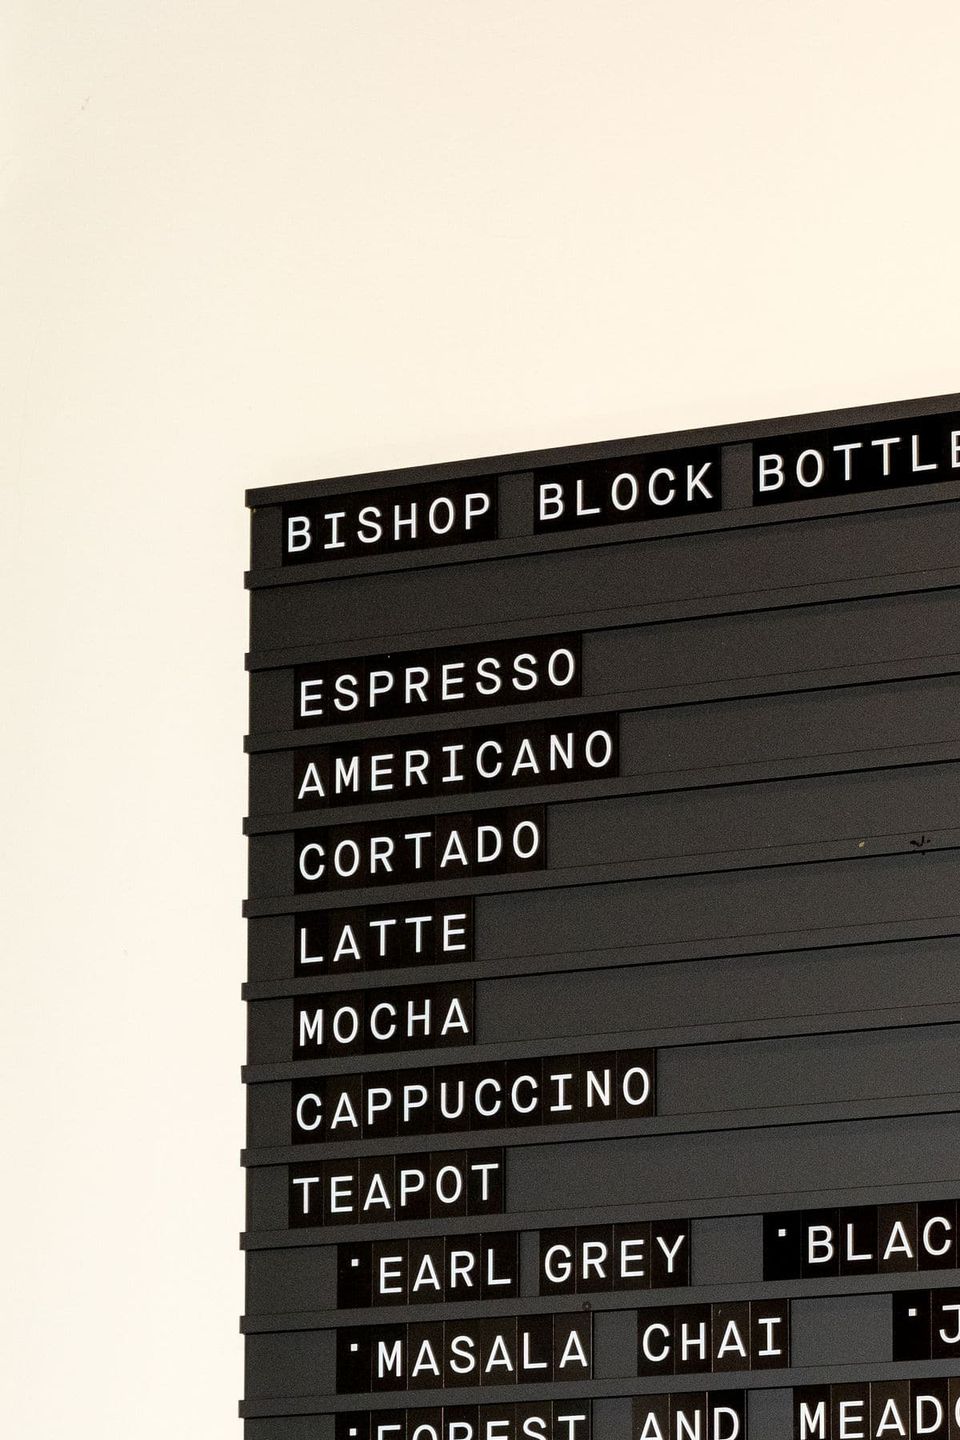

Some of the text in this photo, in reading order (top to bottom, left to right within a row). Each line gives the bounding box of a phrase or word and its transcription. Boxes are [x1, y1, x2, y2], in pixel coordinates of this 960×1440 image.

[286, 491, 491, 553] BISHOP
[539, 462, 713, 521] BLOCK
[300, 648, 575, 717] ESPRESSO
[297, 730, 612, 800] AMERICANO
[299, 820, 539, 881] CORTADO
[300, 913, 466, 964] LATTE
[299, 997, 469, 1047] MOCHA
[296, 1066, 650, 1131] CAPPUCCINO
[292, 1163, 499, 1214] TEAPOT
[544, 1234, 685, 1283] GREY
[642, 1317, 782, 1362] CHAI
